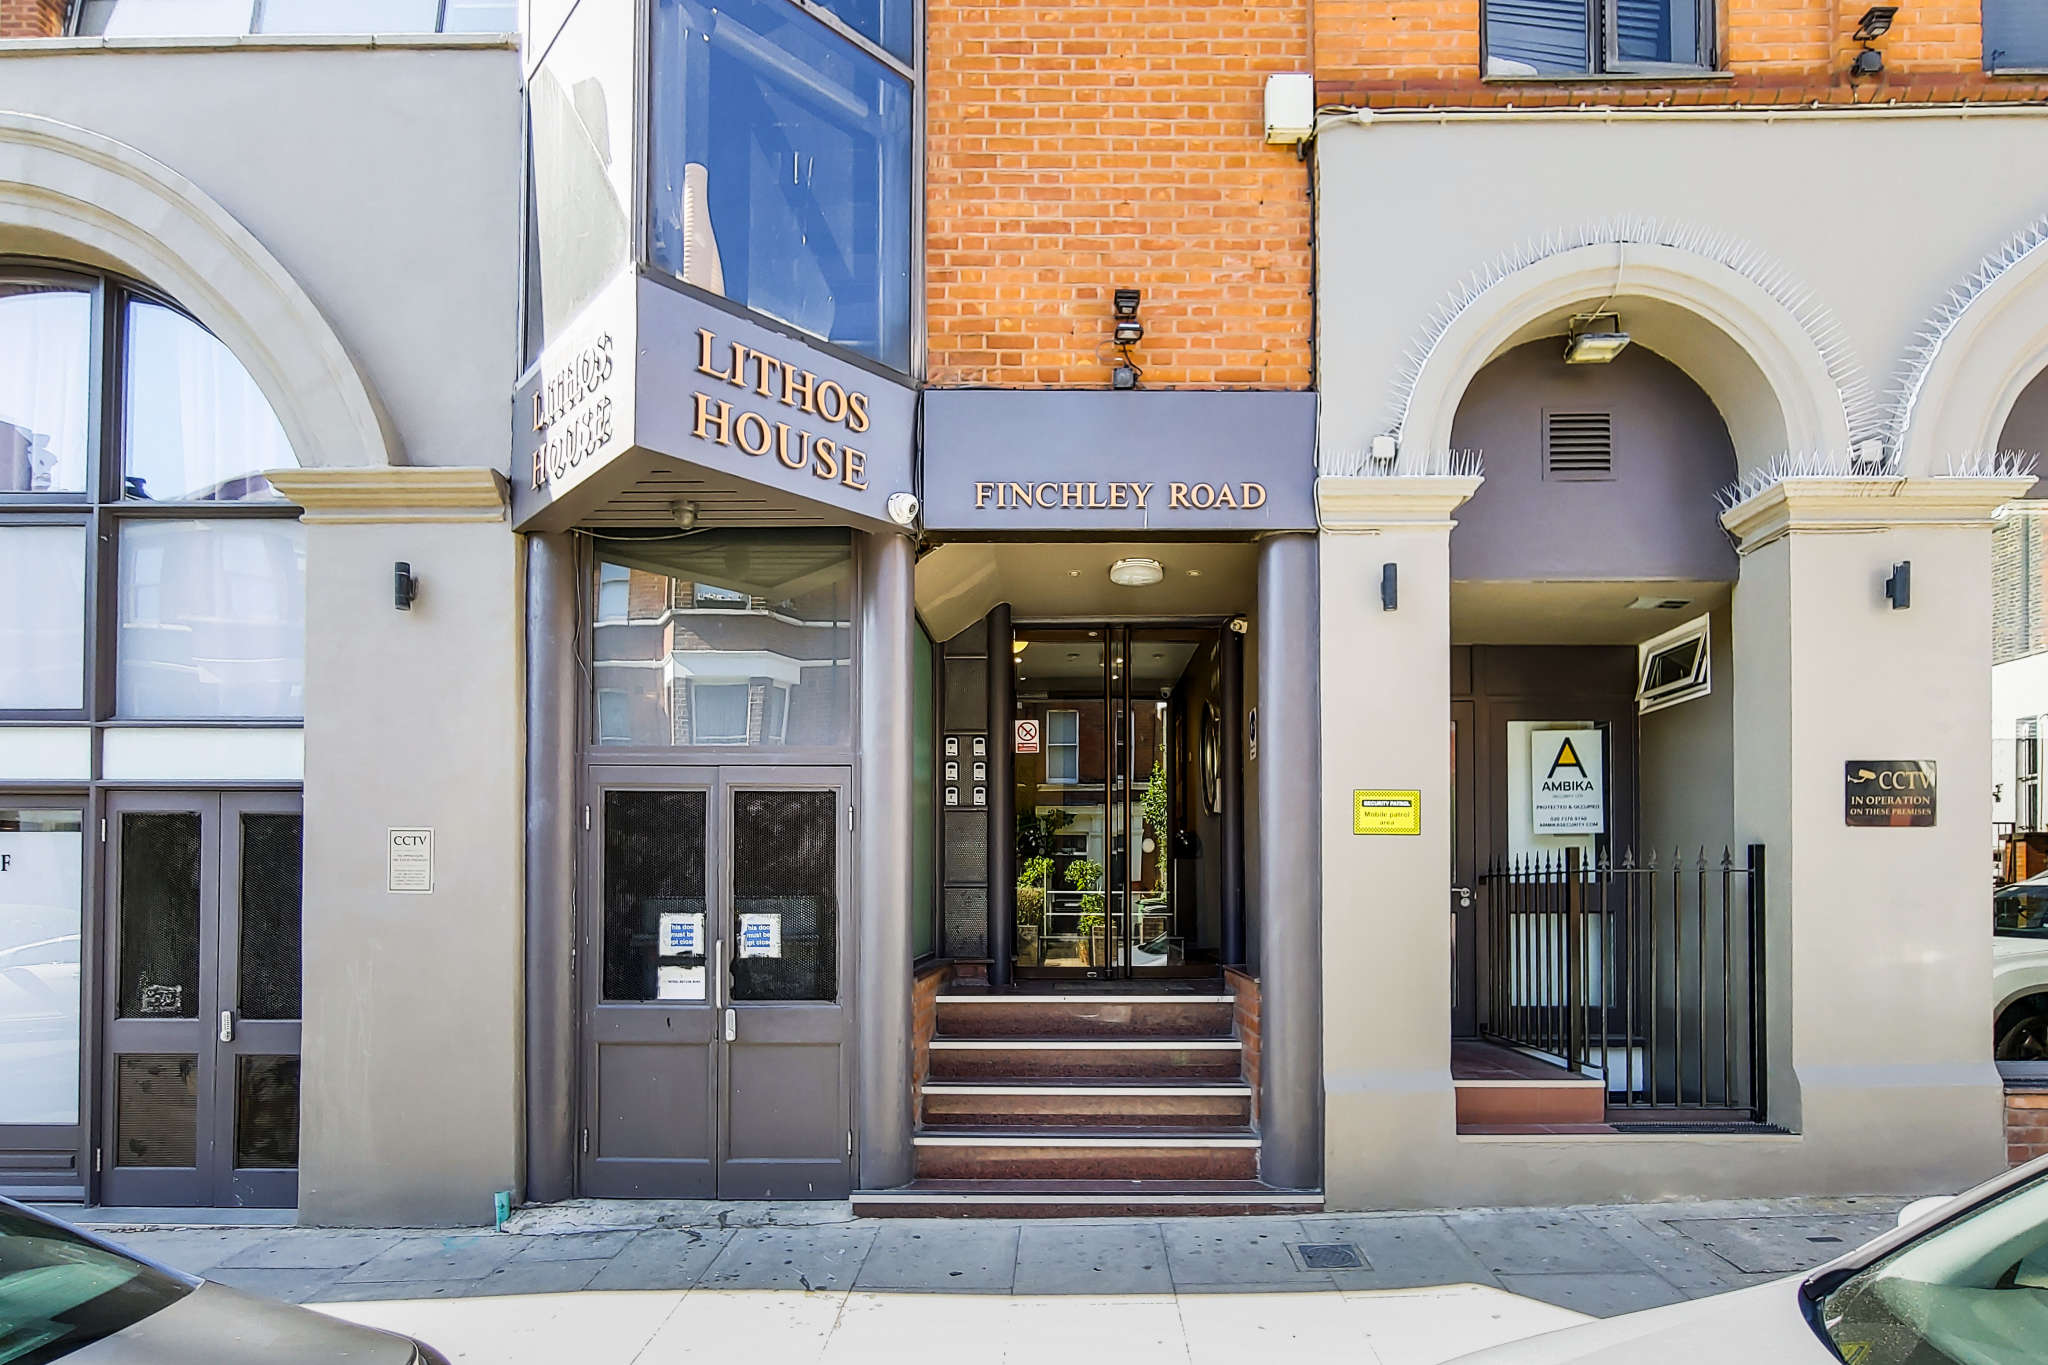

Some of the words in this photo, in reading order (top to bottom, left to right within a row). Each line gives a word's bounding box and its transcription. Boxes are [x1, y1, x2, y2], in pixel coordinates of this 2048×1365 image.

[697, 327, 870, 433] LITHOS
[692, 391, 870, 491] HOUSE
[974, 482, 1154, 509] FINCHLEY
[1167, 482, 1267, 509] ROAD
[1878, 770, 1931, 790] CCTV
[1542, 781, 1594, 792] AMBIKA
[1851, 795, 1864, 805] IN
[1865, 795, 1930, 806] OPERATION
[1389, 811, 1410, 819] patrol
[1850, 807, 1863, 816] ON
[1864, 807, 1890, 816] THESE
[1891, 807, 1932, 816] PREMISES
[393, 835, 427, 846] CCTV
